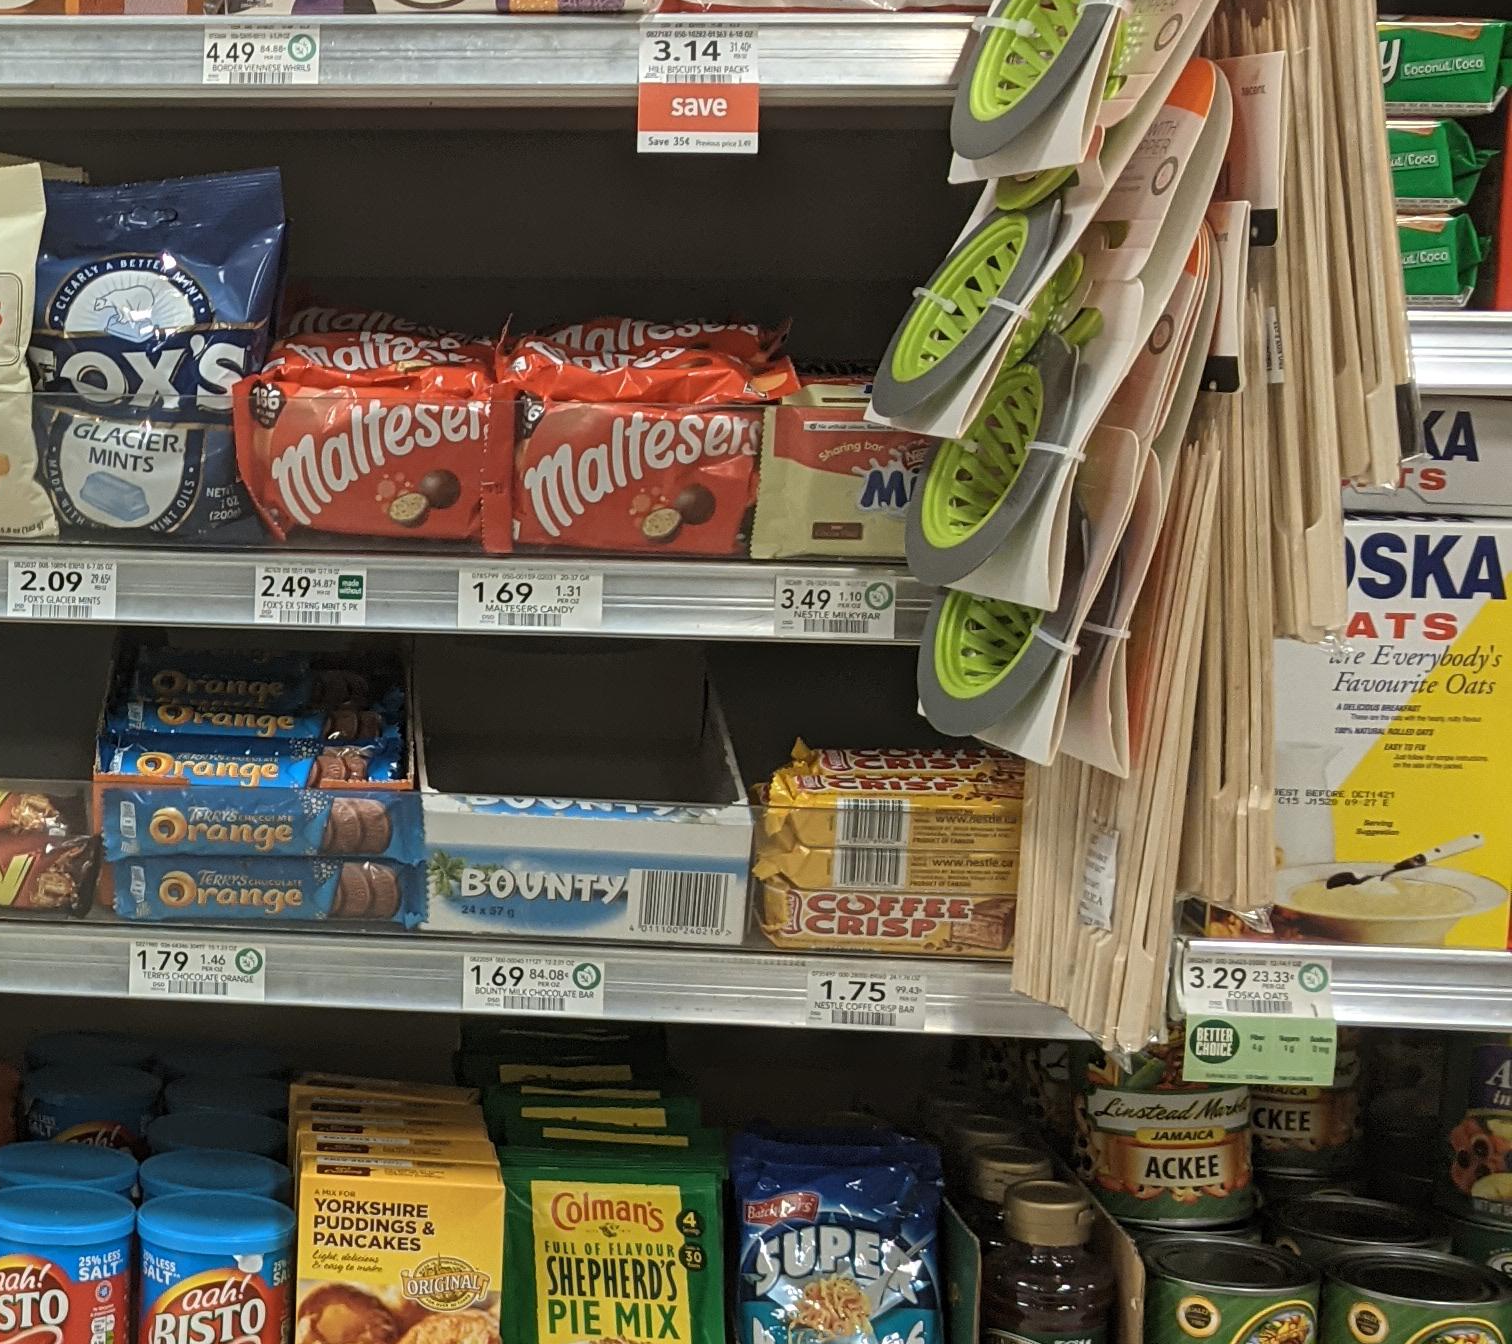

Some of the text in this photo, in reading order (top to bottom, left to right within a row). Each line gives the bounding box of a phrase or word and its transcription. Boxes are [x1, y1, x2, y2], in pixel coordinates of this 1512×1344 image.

[653, 40, 721, 62] 3.14
[671, 96, 726, 117] save
[73, 423, 181, 453] GLACIER
[89, 448, 154, 473] MINTS
[524, 412, 762, 537] Maltesers
[1333, 672, 1495, 695] Favourite Oats
[159, 872, 303, 909] Orange
[460, 869, 625, 902] BOUNTY
[805, 895, 972, 920] COFFEE
[805, 915, 937, 937] CRISP
[1189, 968, 1246, 990] 3.29
[1145, 1156, 1219, 1179] ACKEE
[315, 1199, 429, 1218] YORKSHIRE
[551, 1192, 664, 1232] Colman's
[314, 1215, 417, 1236] PUDDINGS
[313, 1232, 421, 1251] PANCAKES
[547, 1257, 678, 1300] SHEPHERD'S
[548, 1300, 681, 1340] PIE MIX
